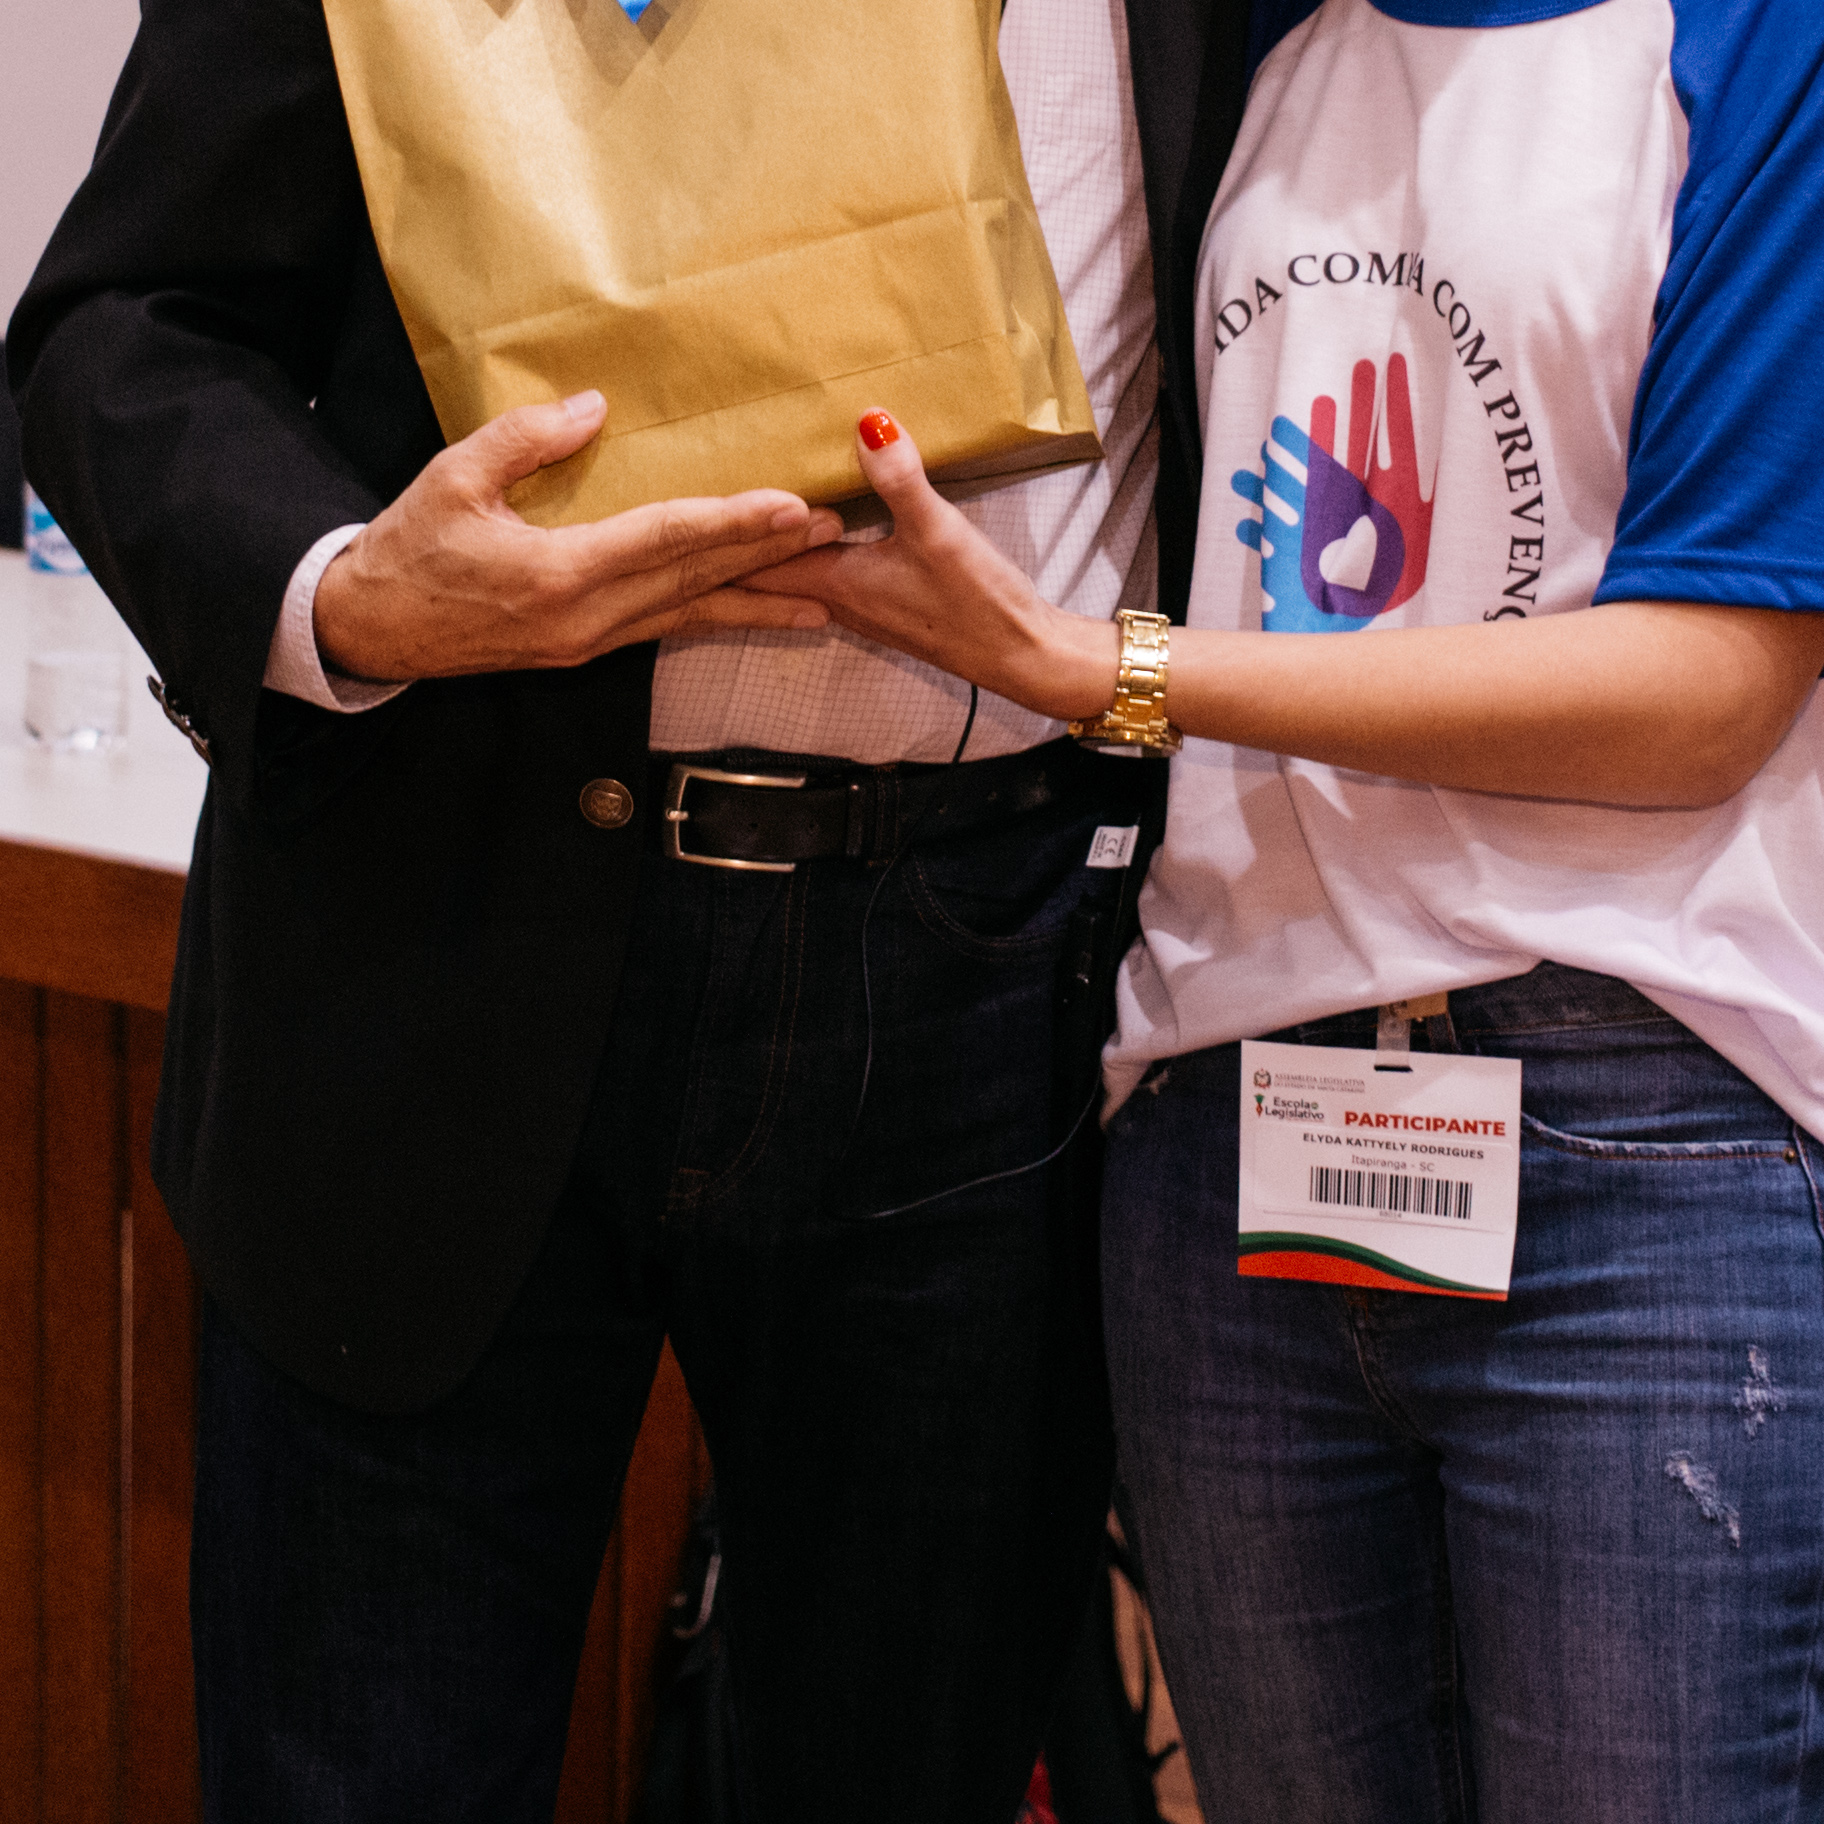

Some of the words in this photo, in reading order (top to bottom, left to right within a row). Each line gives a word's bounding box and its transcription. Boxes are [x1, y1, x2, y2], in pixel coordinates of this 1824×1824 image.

[1214, 276, 1283, 356] IDA
[1433, 279, 1503, 388] COM
[1265, 1105, 1324, 1121] Legislativo
[1273, 1096, 1310, 1110] Escola
[1344, 1110, 1506, 1137] PARTICIPANTE
[1303, 1132, 1342, 1146] ELYDA
[1346, 1137, 1407, 1153] KATTYELY
[1411, 1143, 1484, 1160] RODRIGUES
[1351, 1154, 1407, 1171] Itapiranga
[1419, 1161, 1435, 1173] SC
